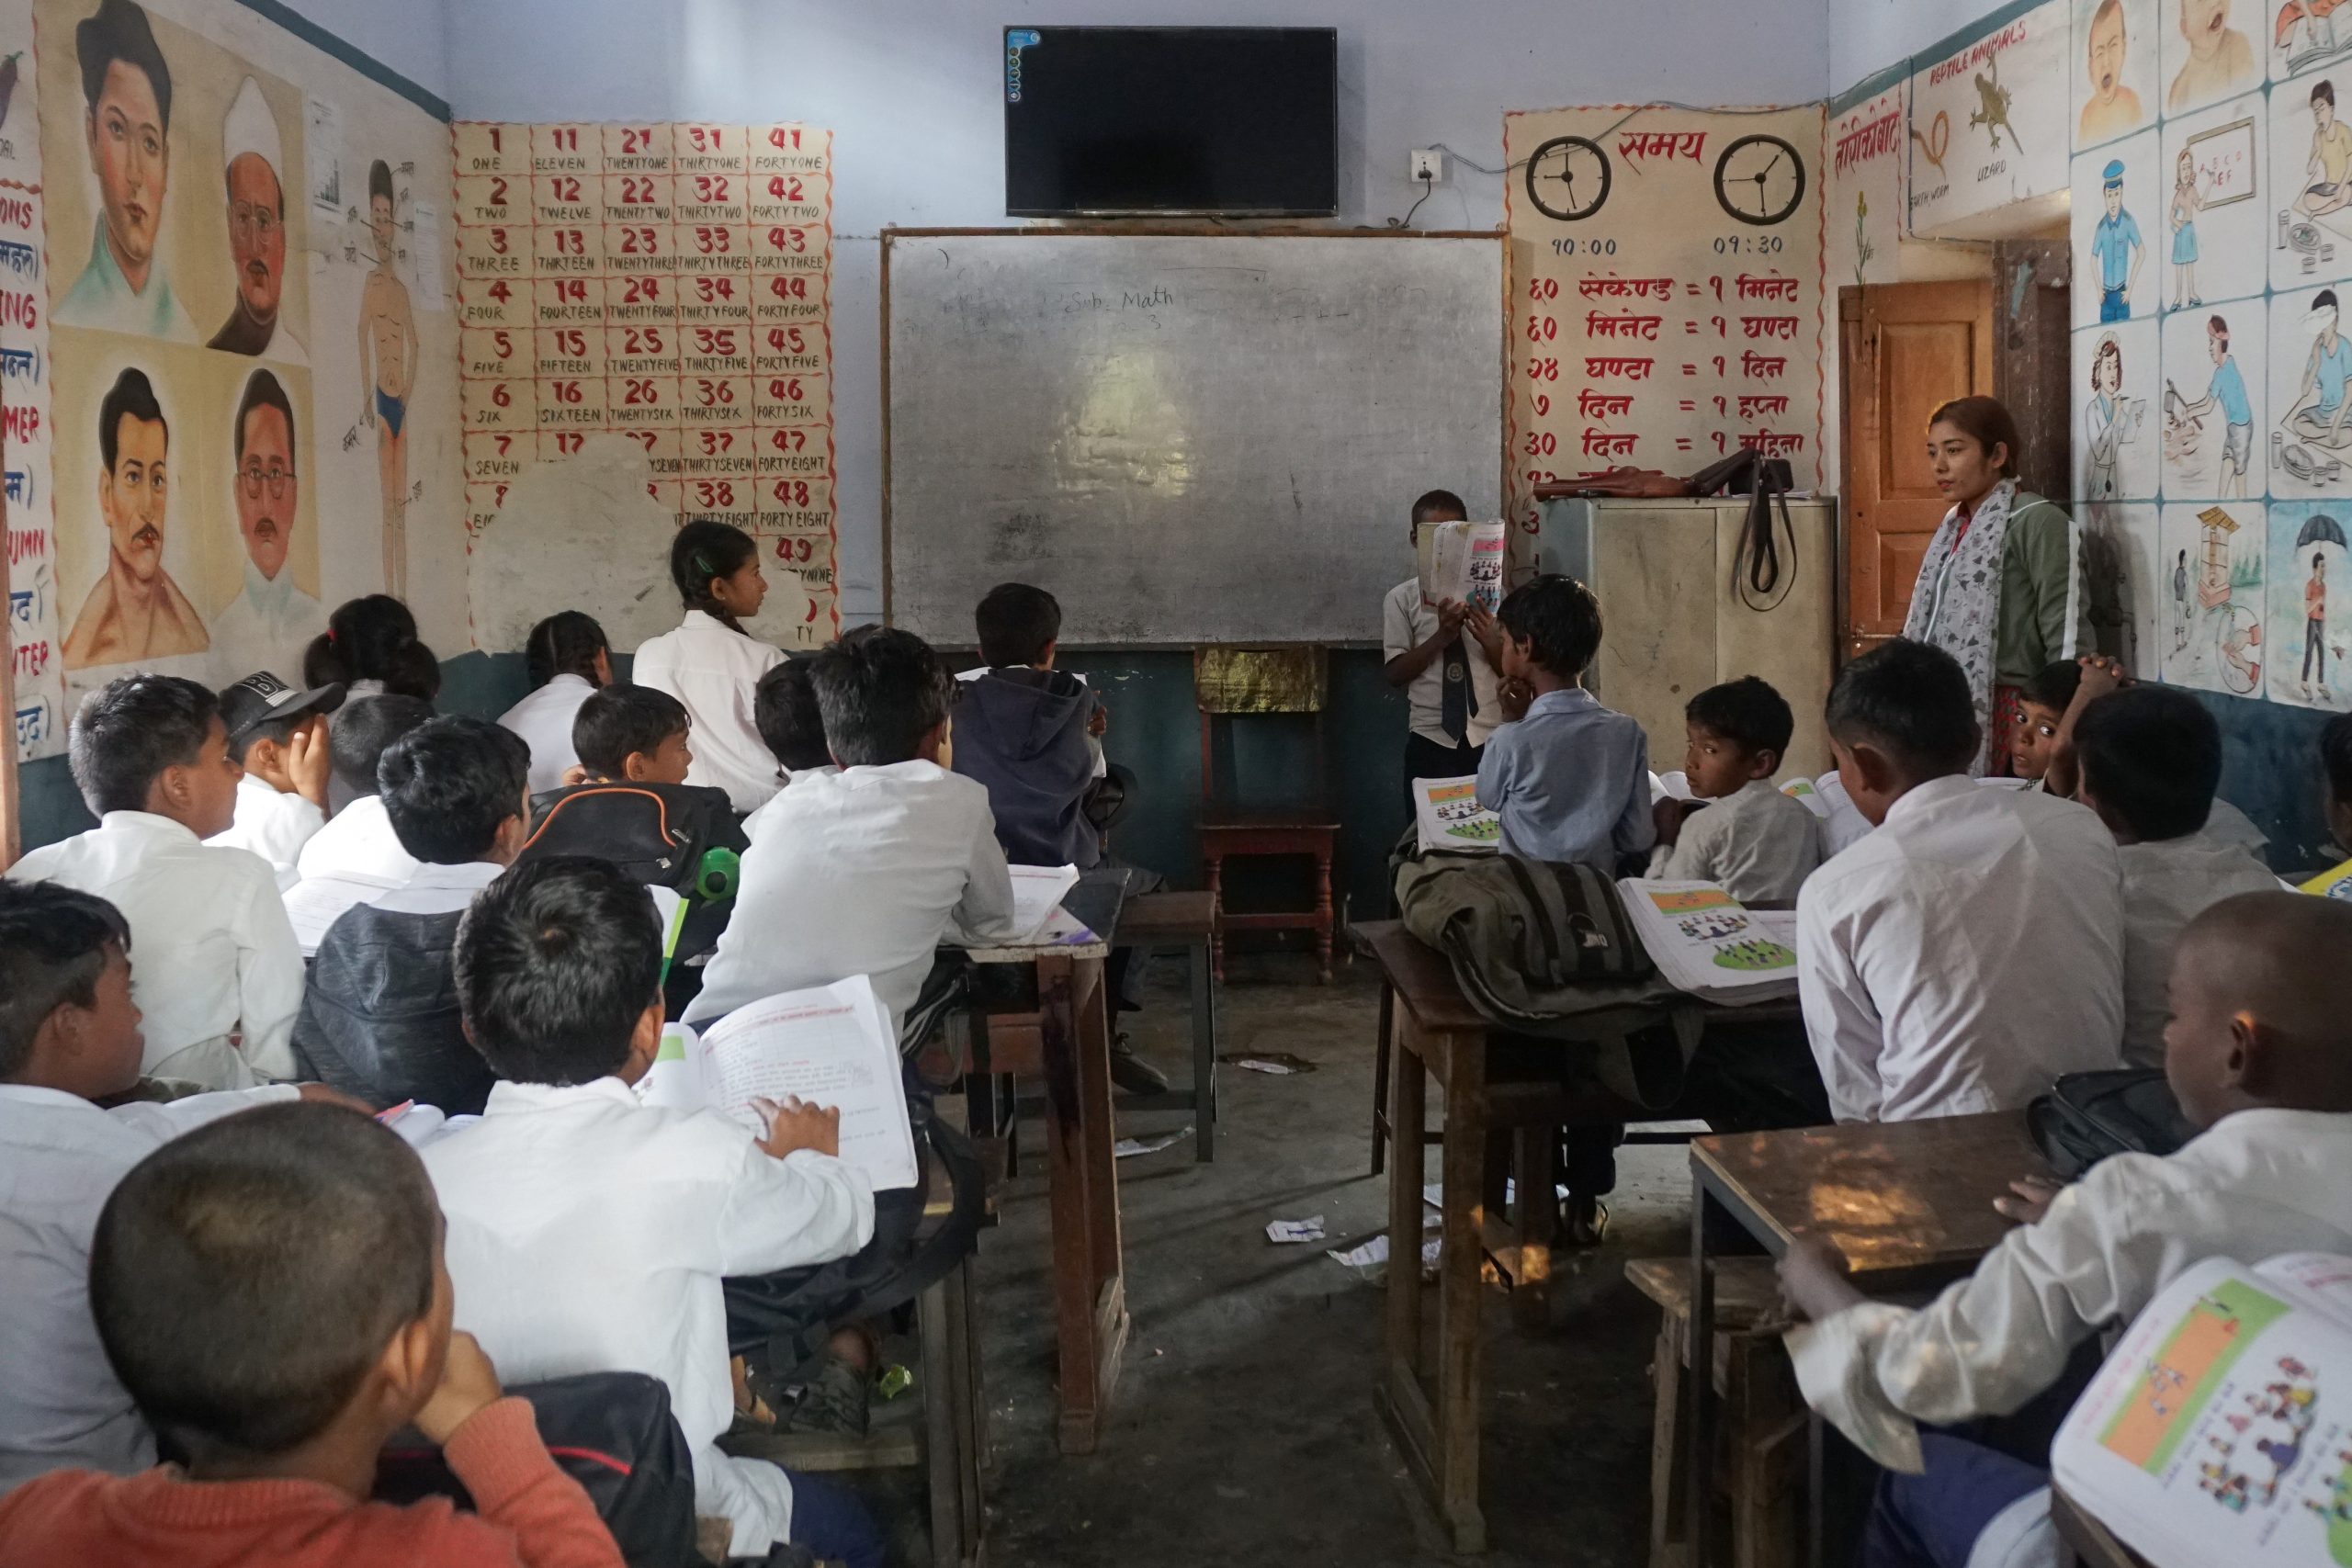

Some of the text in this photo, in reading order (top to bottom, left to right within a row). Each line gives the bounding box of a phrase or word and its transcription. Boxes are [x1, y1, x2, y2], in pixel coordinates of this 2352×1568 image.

[1930, 20, 2027, 86] REPTILE ANIMALS
[489, 128, 501, 153] 1
[552, 128, 577, 152] 11
[621, 128, 650, 154] 21
[690, 127, 721, 152] 31
[768, 127, 801, 151] 41
[472, 157, 501, 170] ONE
[536, 157, 585, 170] ELEVEN
[1618, 130, 1708, 175] समय
[1977, 160, 2007, 183] LIZARD
[490, 176, 508, 205] 2
[551, 176, 581, 202] 12
[621, 176, 655, 203] 22
[692, 175, 729, 203] 32
[767, 175, 803, 201] 42
[1930, 184, 1950, 200] WORM
[474, 207, 507, 219] TWO
[539, 206, 592, 220] TWELVE
[486, 228, 508, 254] 3
[554, 230, 584, 254] 13
[621, 227, 657, 254] 23
[693, 227, 729, 254] 33
[767, 227, 806, 253] 43
[468, 256, 519, 272] THREE
[538, 256, 594, 272] THIRTEEN
[488, 280, 513, 305] 4
[554, 279, 589, 304] 14
[624, 277, 660, 303] 24
[694, 277, 735, 302] 34
[770, 276, 808, 301] 44
[1122, 284, 1173, 310] Math
[1529, 277, 1559, 306] ६०
[467, 306, 505, 320] FOUR
[540, 305, 602, 320] FOURTEEN
[554, 330, 586, 356] 15
[625, 328, 663, 354] 25
[693, 328, 737, 355] 35
[767, 328, 806, 353] 45
[1527, 315, 1557, 347] ६०
[1740, 315, 1801, 340] घण्टा
[492, 331, 513, 359] 5
[473, 361, 503, 374] FIVE
[540, 359, 591, 373] FIFTEEN
[1527, 357, 1559, 386] २४
[1585, 356, 1656, 381] घण्टा
[1740, 349, 1788, 386] दिन
[492, 383, 511, 407] 6
[552, 380, 582, 404] 16
[625, 378, 657, 404] 26
[695, 379, 733, 406] 36
[768, 378, 803, 400] 46
[476, 410, 501, 424] SIX
[541, 409, 601, 423] SIXTEEN
[1577, 388, 1634, 428] दिन
[1737, 395, 1790, 424] हप्ता
[494, 434, 512, 458] 7
[555, 433, 584, 455] 17
[696, 431, 733, 456] 37
[771, 430, 806, 453] 47
[1580, 427, 1640, 462] दिन
[475, 460, 519, 475] SEVEN
[695, 481, 734, 508] 38
[773, 480, 809, 509] 48
